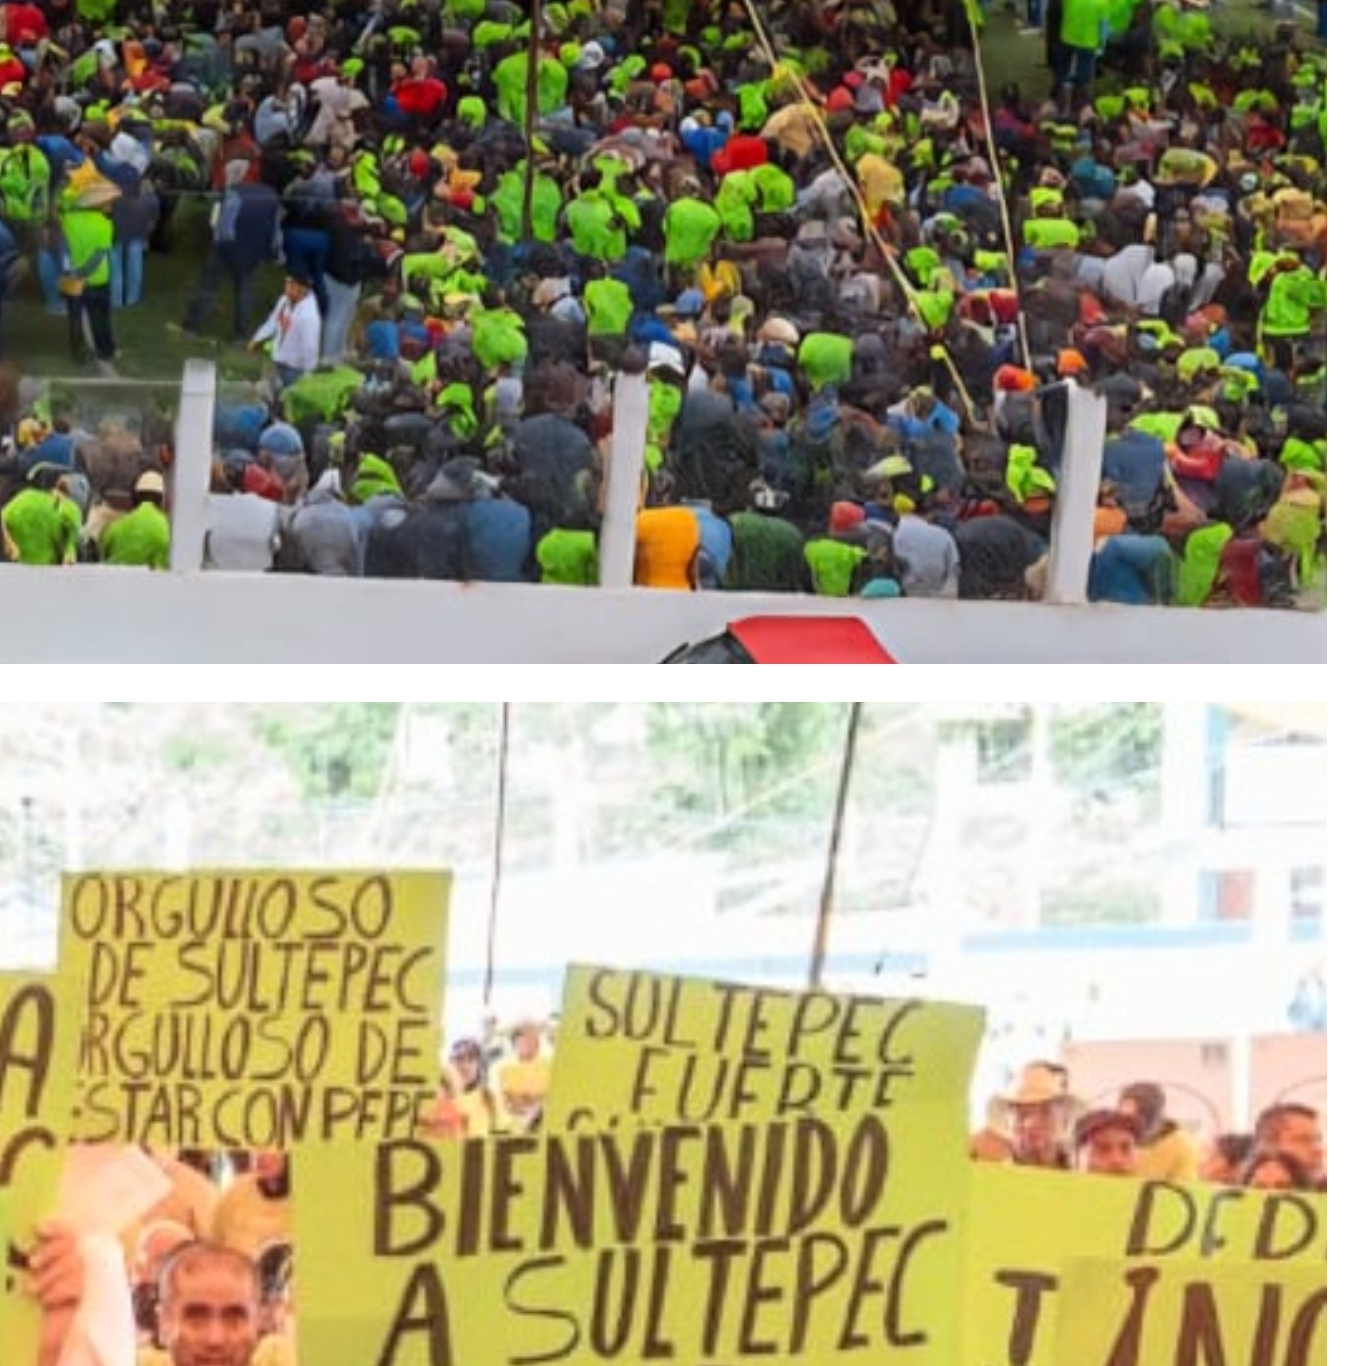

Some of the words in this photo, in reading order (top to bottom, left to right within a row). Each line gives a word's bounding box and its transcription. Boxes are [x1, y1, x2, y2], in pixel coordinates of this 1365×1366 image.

[88, 941, 152, 1008] DE
[171, 940, 435, 1014] SULTEPEC
[78, 1011, 330, 1083] RGULLOSO
[357, 1019, 431, 1085] DE
[69, 1080, 203, 1151] STAR
[213, 1084, 312, 1150] CON
[373, 1113, 891, 1259] BIENVENIDO
[504, 1219, 949, 1366] SULTEPEC
